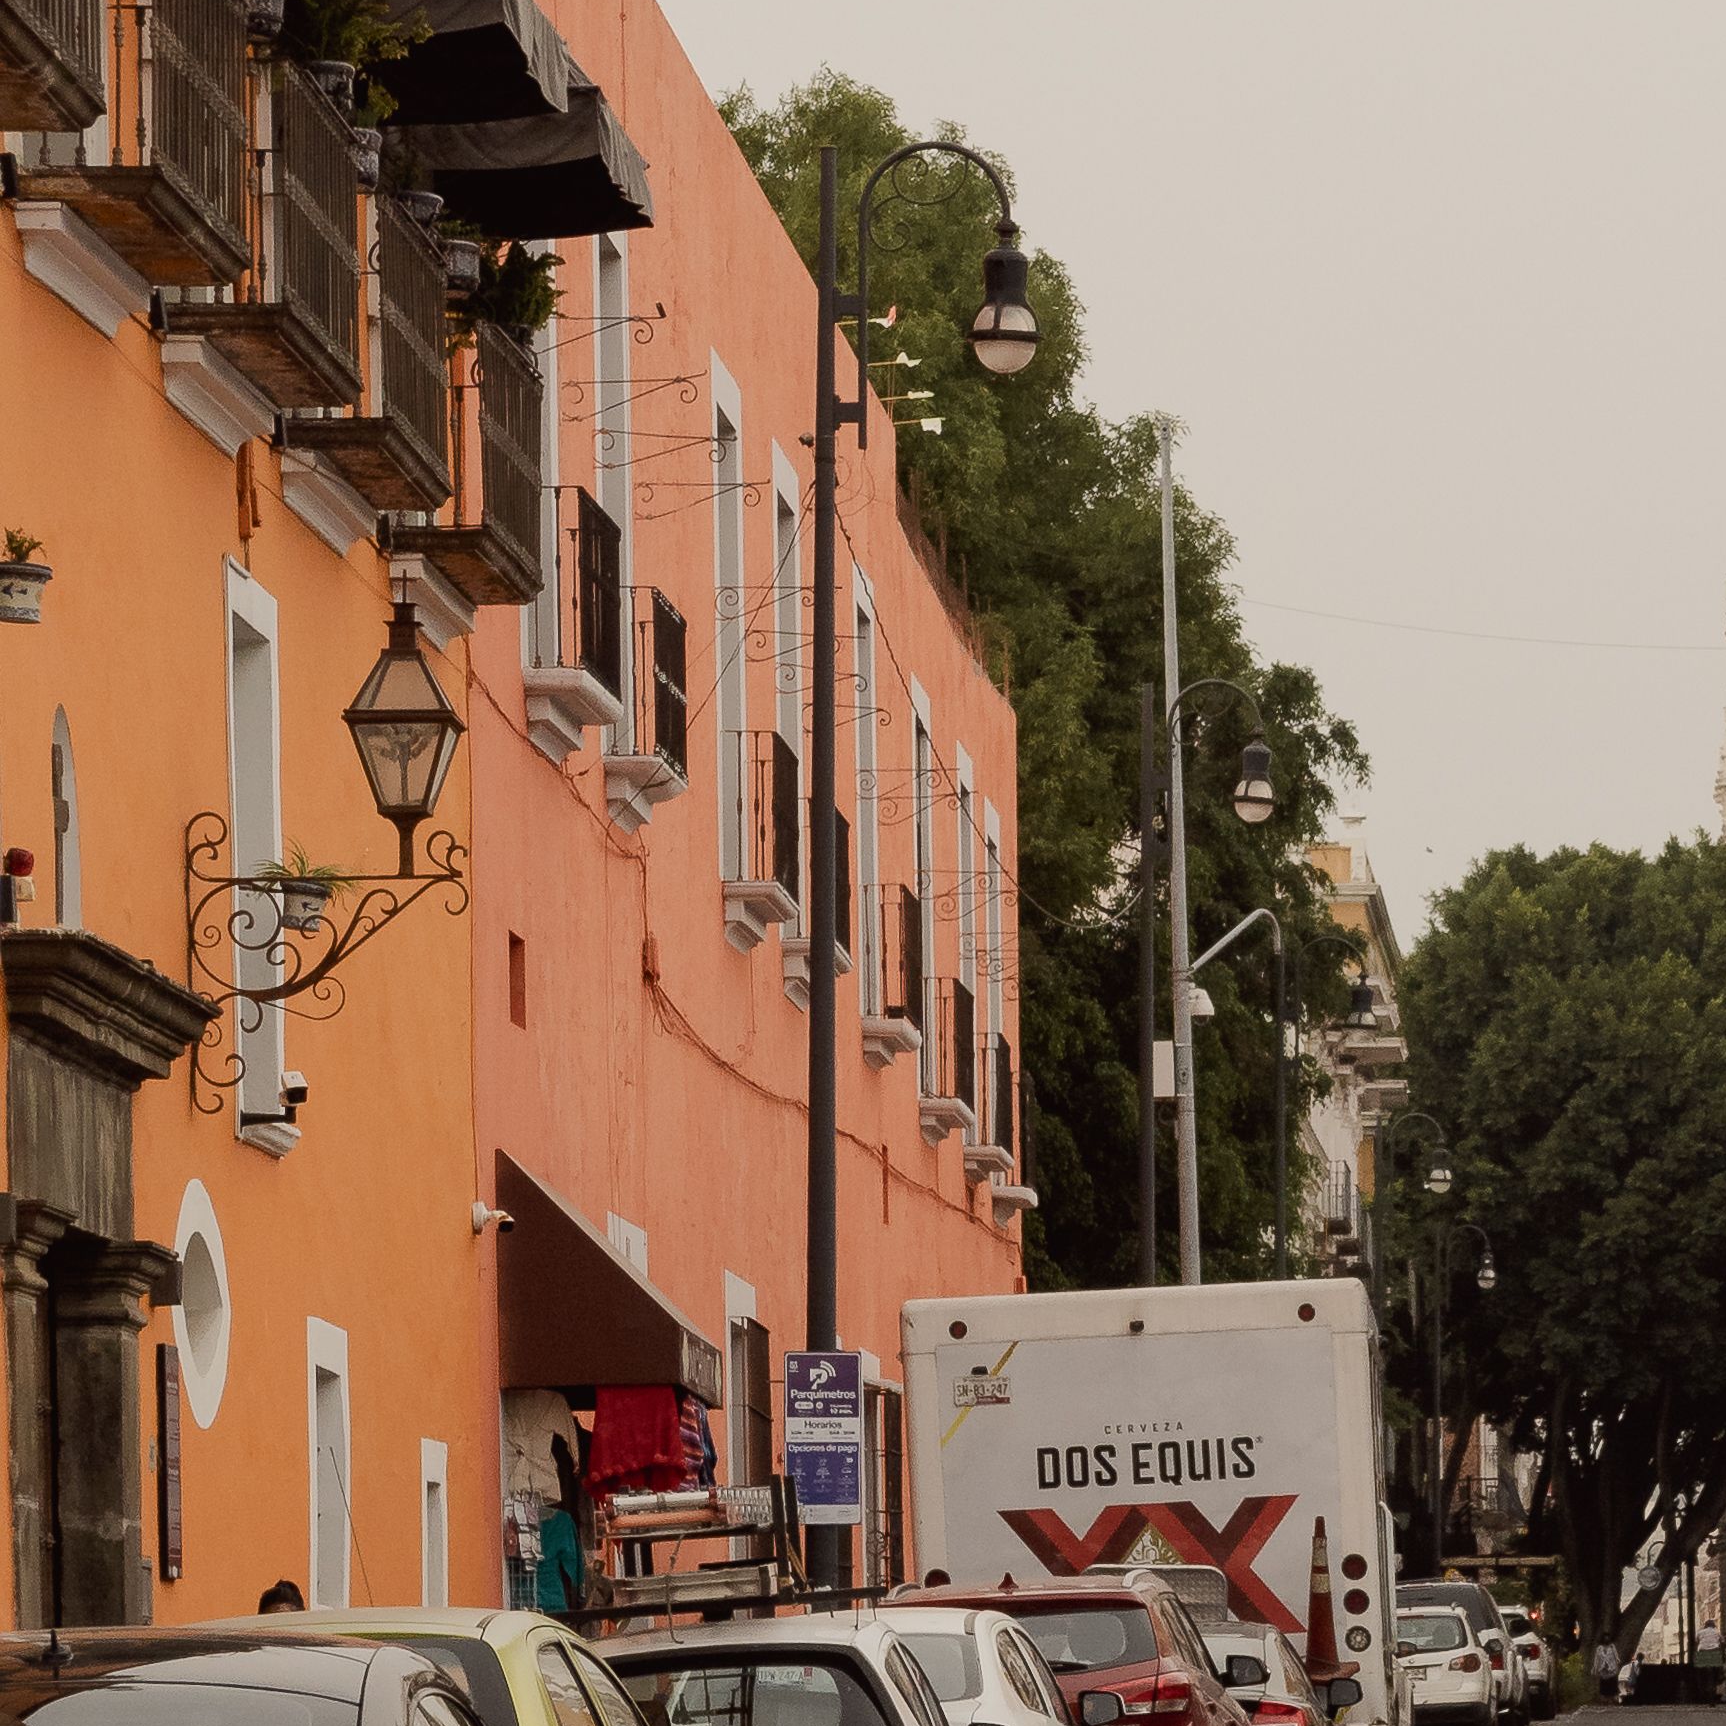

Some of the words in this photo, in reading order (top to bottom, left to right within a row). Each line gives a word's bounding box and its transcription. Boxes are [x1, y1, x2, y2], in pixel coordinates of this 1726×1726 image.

[803, 1420, 843, 1429] Horarios
[1103, 1421, 1185, 1435] CERVEZA
[788, 1444, 826, 1454] Opciones
[826, 1444, 837, 1452] de
[837, 1445, 858, 1454] pago
[1036, 1443, 1118, 1490] DOS
